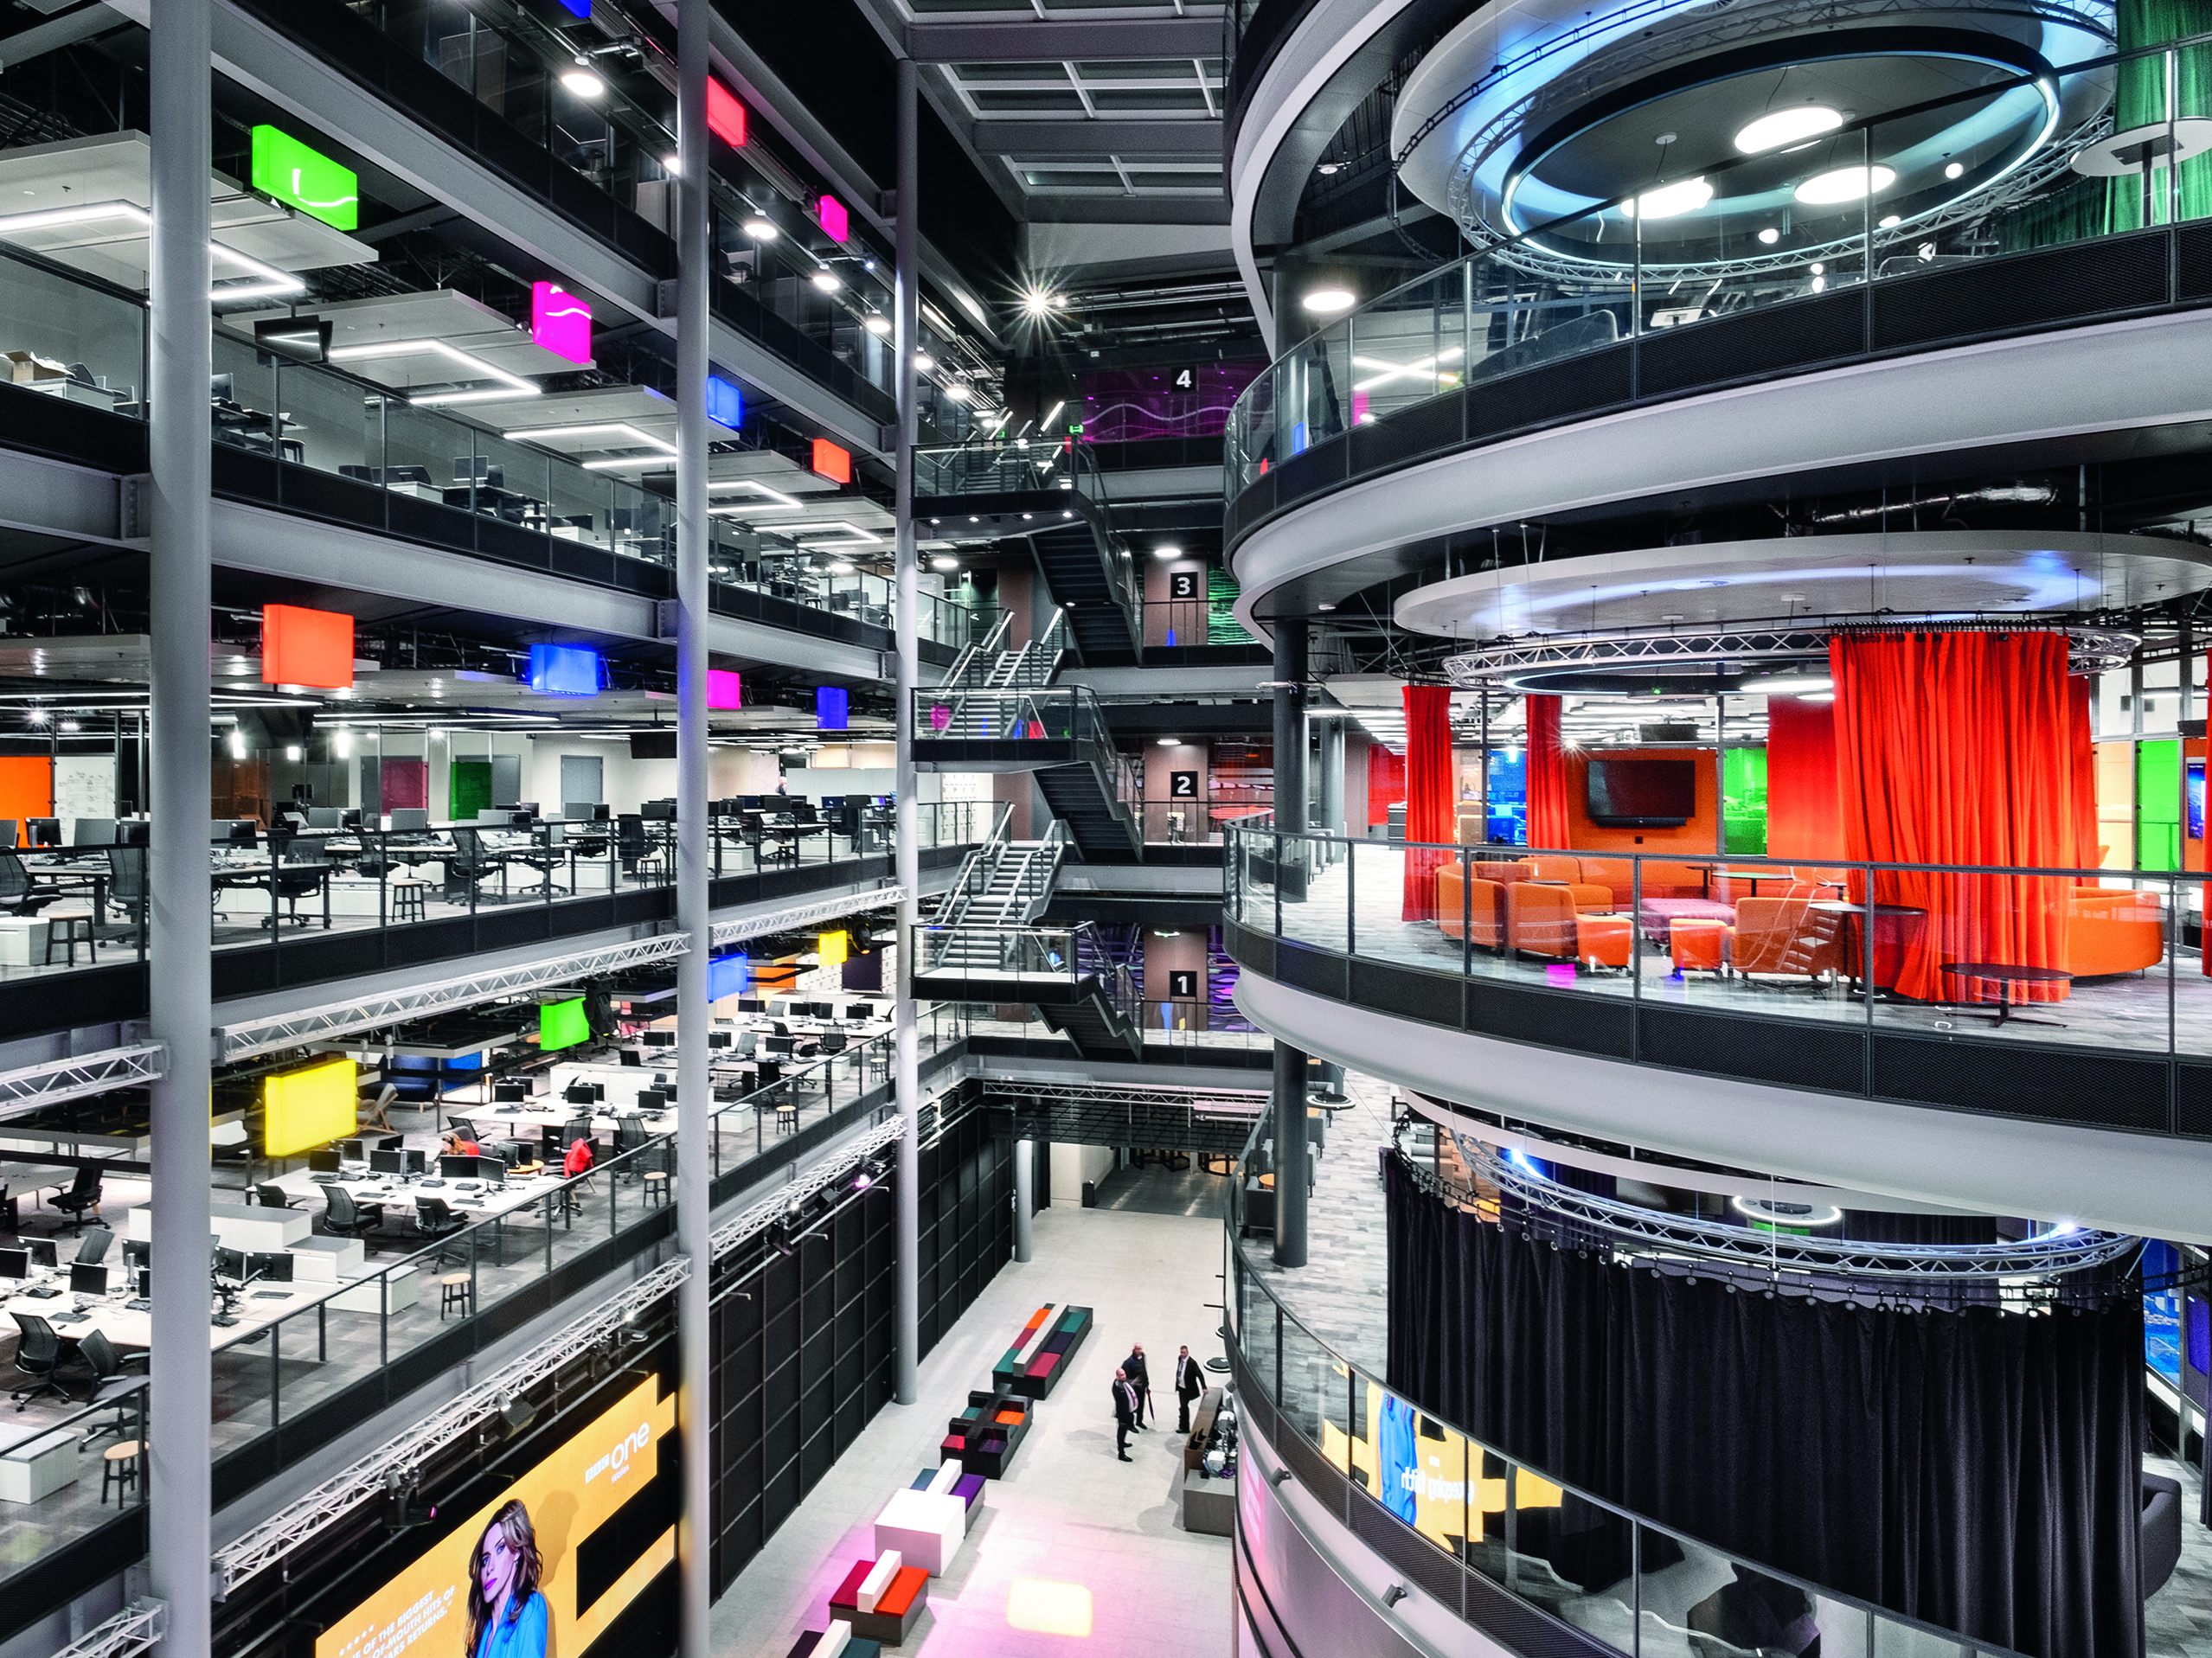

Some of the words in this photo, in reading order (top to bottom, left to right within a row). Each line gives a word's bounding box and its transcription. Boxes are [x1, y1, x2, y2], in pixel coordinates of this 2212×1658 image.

[1176, 369, 1192, 388] 4
[1177, 577, 1190, 595] 3
[1177, 776, 1191, 794] 2
[1177, 976, 1188, 994] 1
[585, 1453, 610, 1484] BBC
[611, 1422, 650, 1469] one
[423, 1597, 442, 1617] HITS
[443, 1584, 455, 1601] OF
[363, 1637, 376, 1655] OF
[378, 1622, 395, 1642] THE
[397, 1590, 433, 1627] BIGGEST
[384, 1641, 406, 1658] ARS
